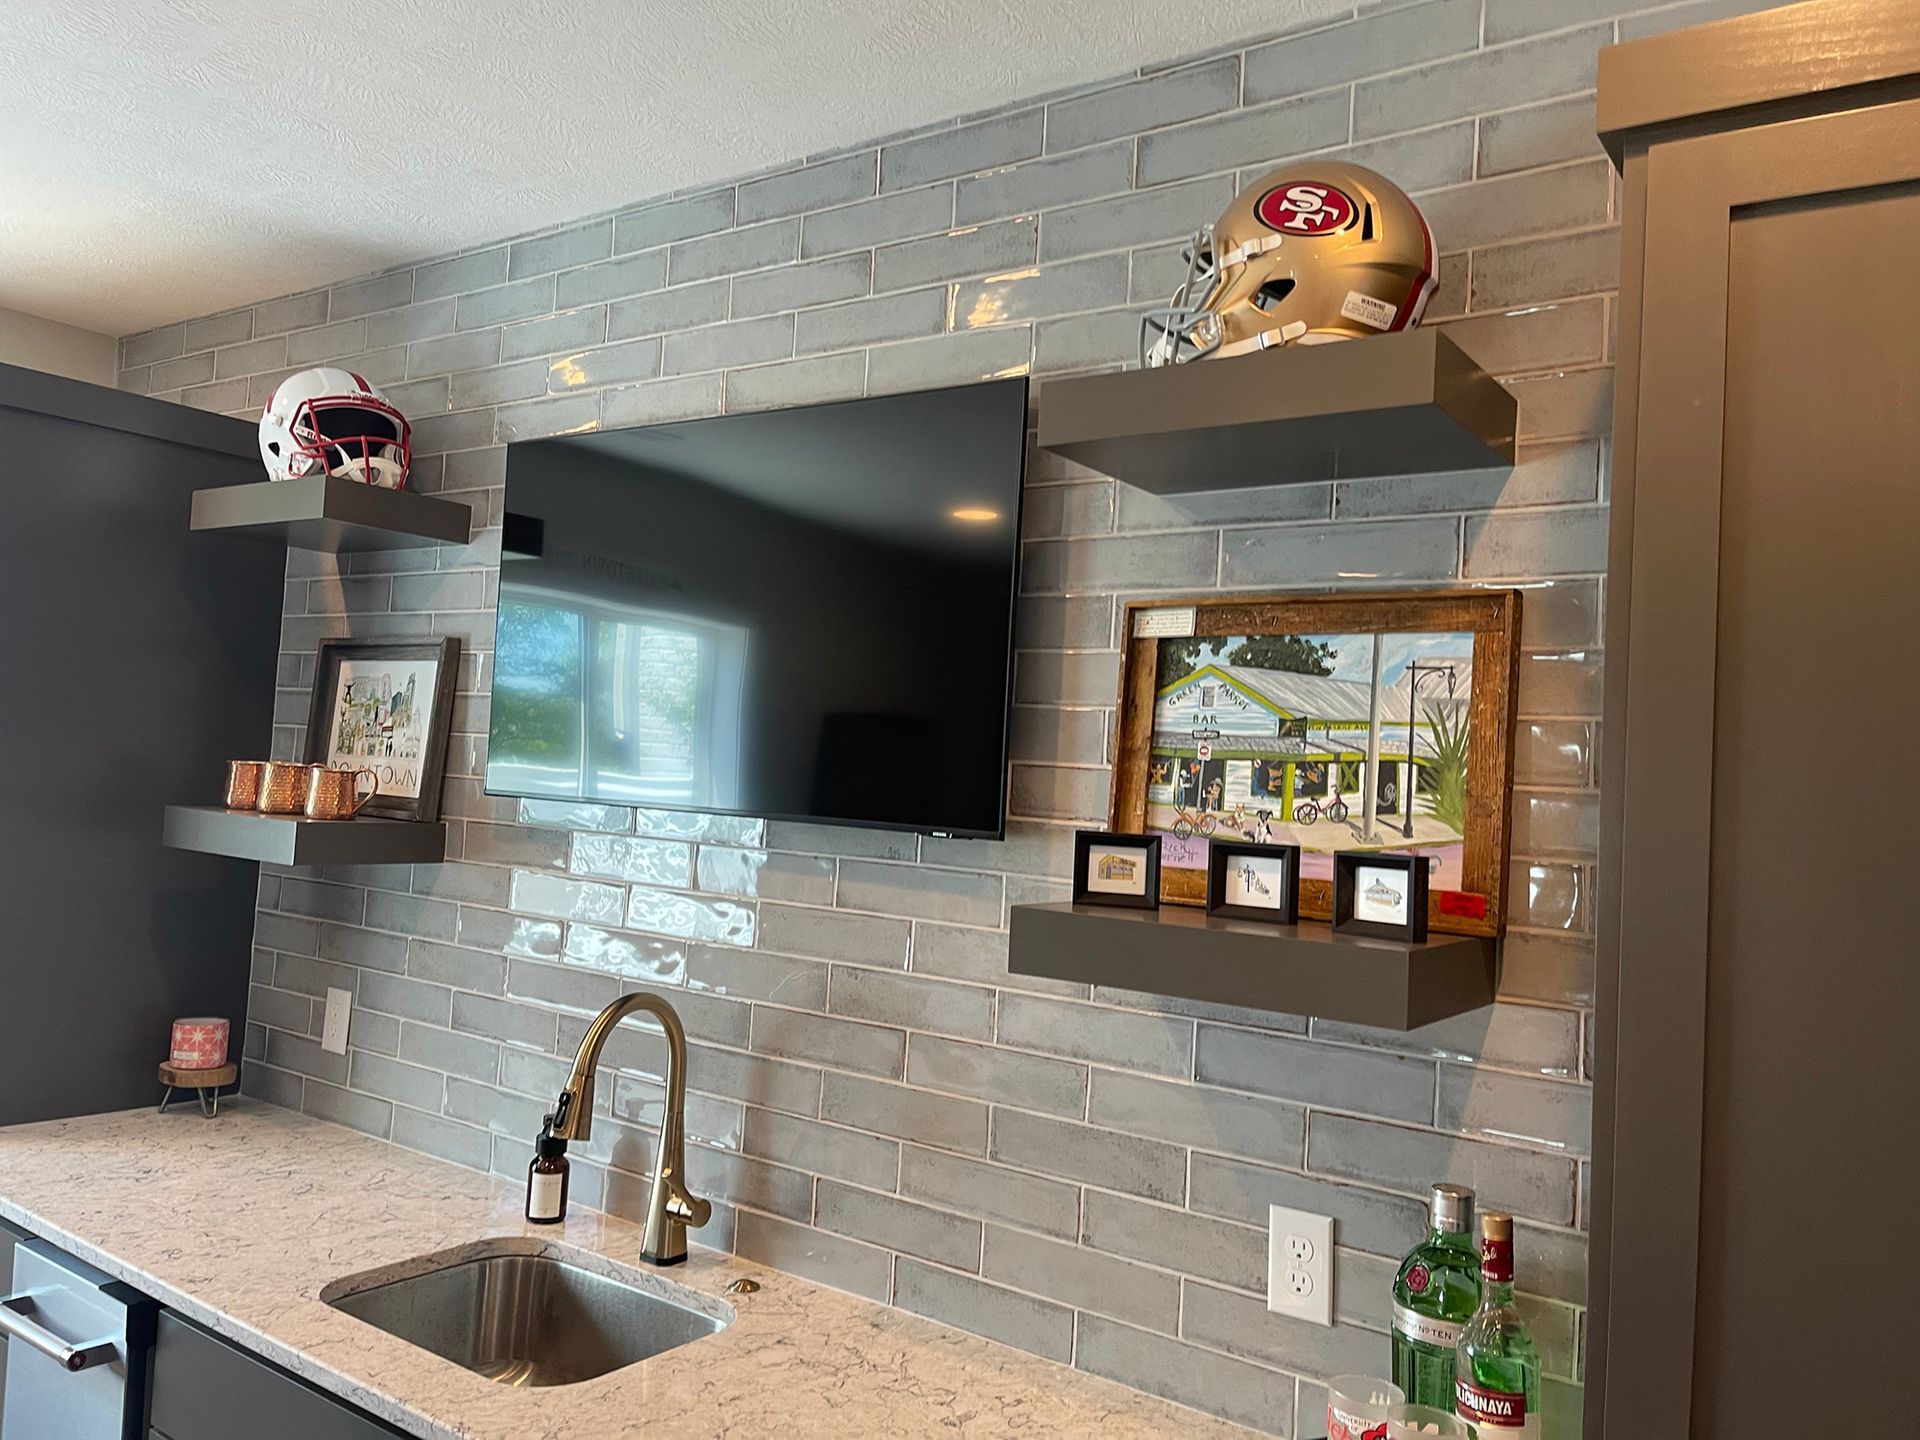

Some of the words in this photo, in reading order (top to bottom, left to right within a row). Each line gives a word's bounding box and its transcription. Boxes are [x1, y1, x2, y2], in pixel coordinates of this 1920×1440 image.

[1360, 297, 1387, 312] WARNING
[1218, 683, 1252, 711] PARROT
[1192, 714, 1218, 725] BAR
[1431, 1328, 1453, 1341] TEN
